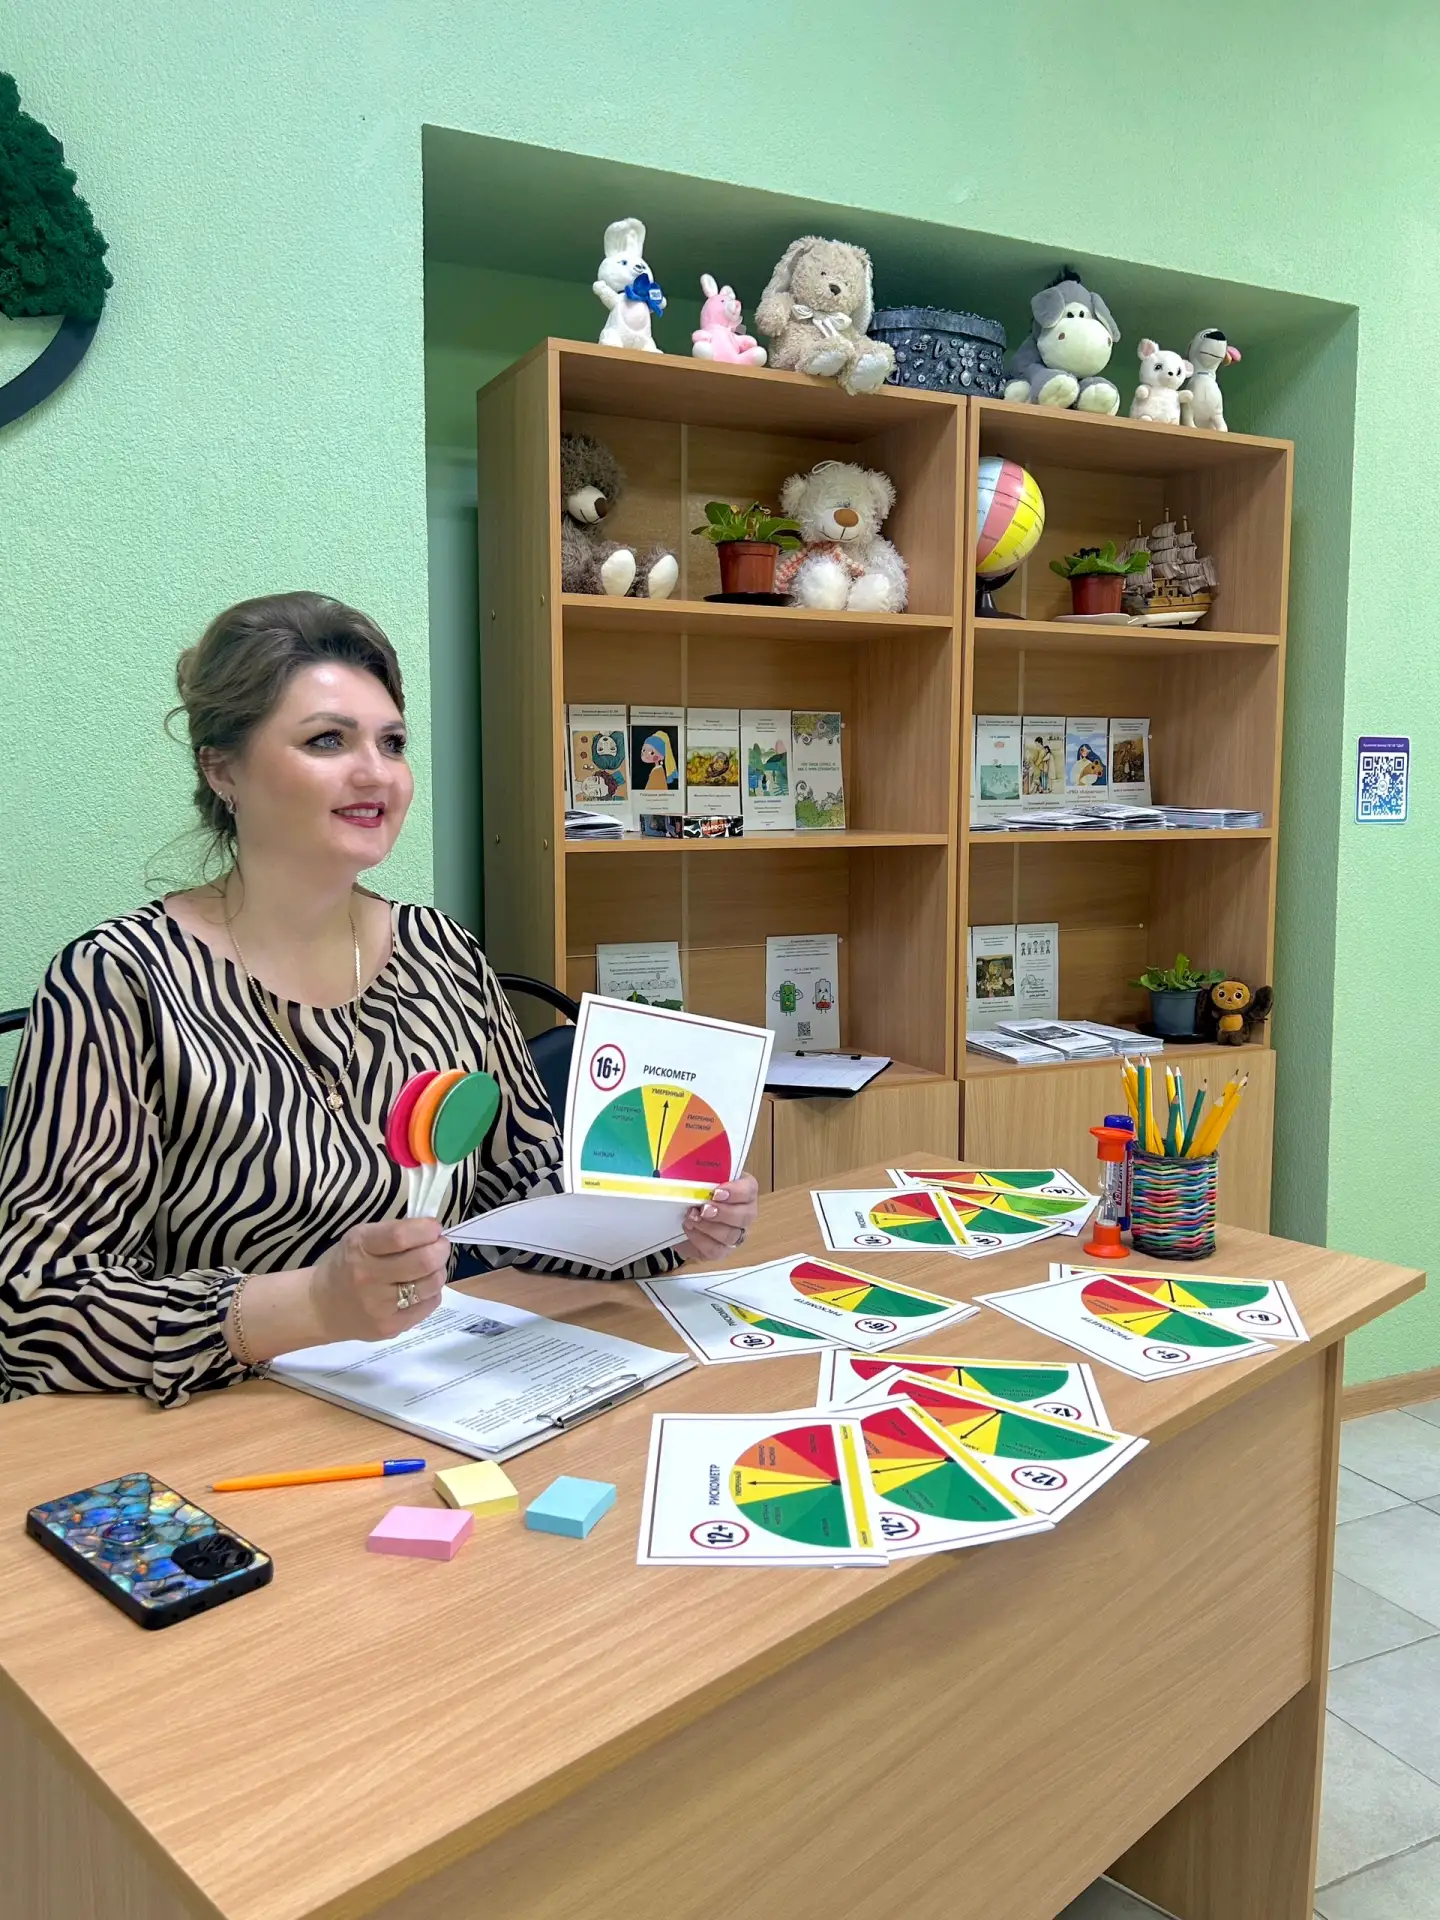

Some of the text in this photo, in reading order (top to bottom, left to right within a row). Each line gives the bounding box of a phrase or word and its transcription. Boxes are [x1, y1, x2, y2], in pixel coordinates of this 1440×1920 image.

[596, 1056, 621, 1079] 16+
[643, 1064, 697, 1082] РИСКОМЕТР
[651, 1087, 685, 1098] УМЕРЕННЫЙ
[685, 1123, 712, 1131] ВЫСОКИЙ
[687, 1114, 715, 1123] УМЕРЕННО
[793, 1298, 844, 1317] РИСКОМЕТР
[1246, 1313, 1270, 1322] 6+
[864, 1321, 890, 1332] 16+
[1080, 1316, 1134, 1341] РИСКОМЕТР
[743, 1334, 766, 1347] 16+
[1156, 1349, 1181, 1360] 6+
[708, 1464, 720, 1506] РИСКОМЕТР
[1022, 1469, 1058, 1486] 12+
[706, 1524, 734, 1545] 12+
[879, 1515, 909, 1537] 12+
